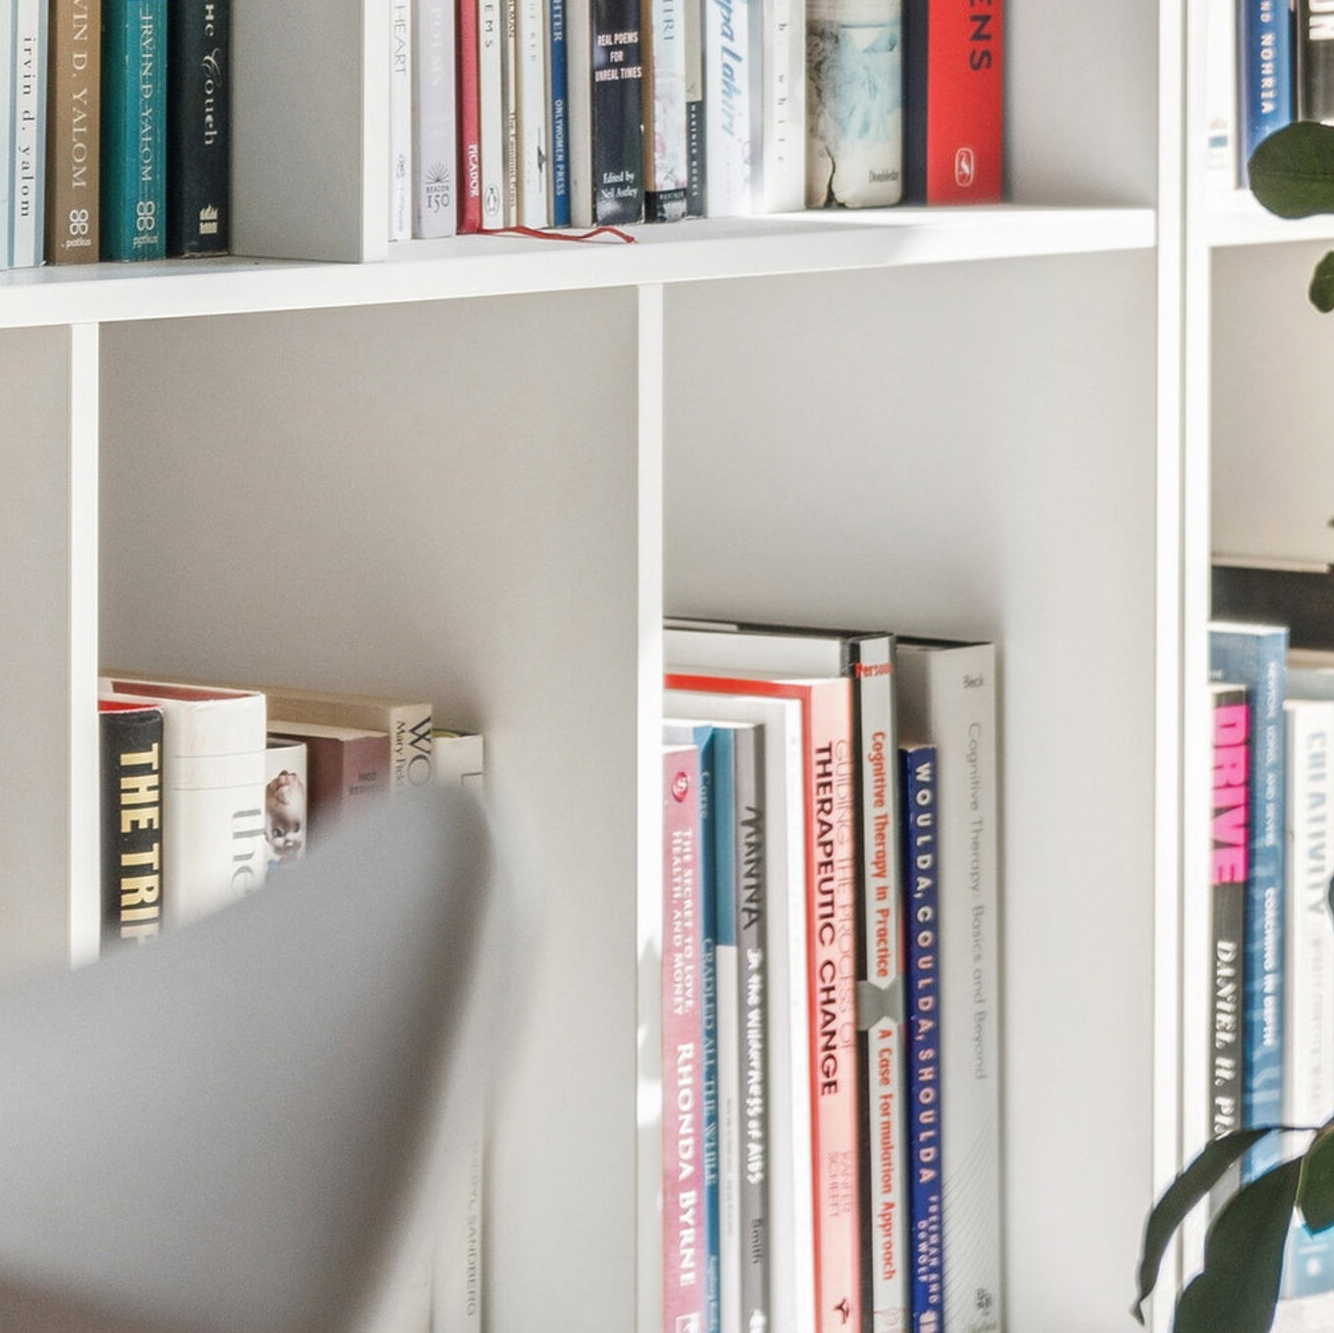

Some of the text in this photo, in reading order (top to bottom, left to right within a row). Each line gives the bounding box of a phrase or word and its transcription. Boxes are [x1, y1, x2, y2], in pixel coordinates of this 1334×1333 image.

[393, 5, 406, 76] HEART
[594, 65, 643, 83] UNREAL TIMES
[597, 31, 639, 47] REAL POEMS
[609, 50, 624, 64] FOR
[1260, 33, 1277, 115] NOHRIA
[17, 146, 35, 219] yalom
[71, 88, 88, 188] YALOM
[468, 143, 479, 198] PICADOR
[426, 193, 451, 213] 150
[120, 741, 160, 834] THE
[395, 720, 406, 754] Mary
[1212, 704, 1250, 885] DRIVE
[1306, 730, 1327, 914] CREATIVITY
[740, 805, 764, 932] MANNA
[867, 730, 891, 979] Cognitive Therapy Practice
[965, 721, 988, 1080] Cognitive Basics Beyond
[672, 830, 685, 1017] HEALTH, MONEY
[683, 867, 696, 1014] SECRET LOVE,
[814, 741, 838, 1097] THERAPEUTIC CHANGE
[913, 761, 937, 1184] WOULDA, SHOULDA
[1214, 939, 1238, 1051] DANIEL
[676, 1042, 697, 1288] RHONDA BYRNE
[877, 1047, 897, 1282] Case Formulation Approach
[750, 1217, 765, 1266] Smith
